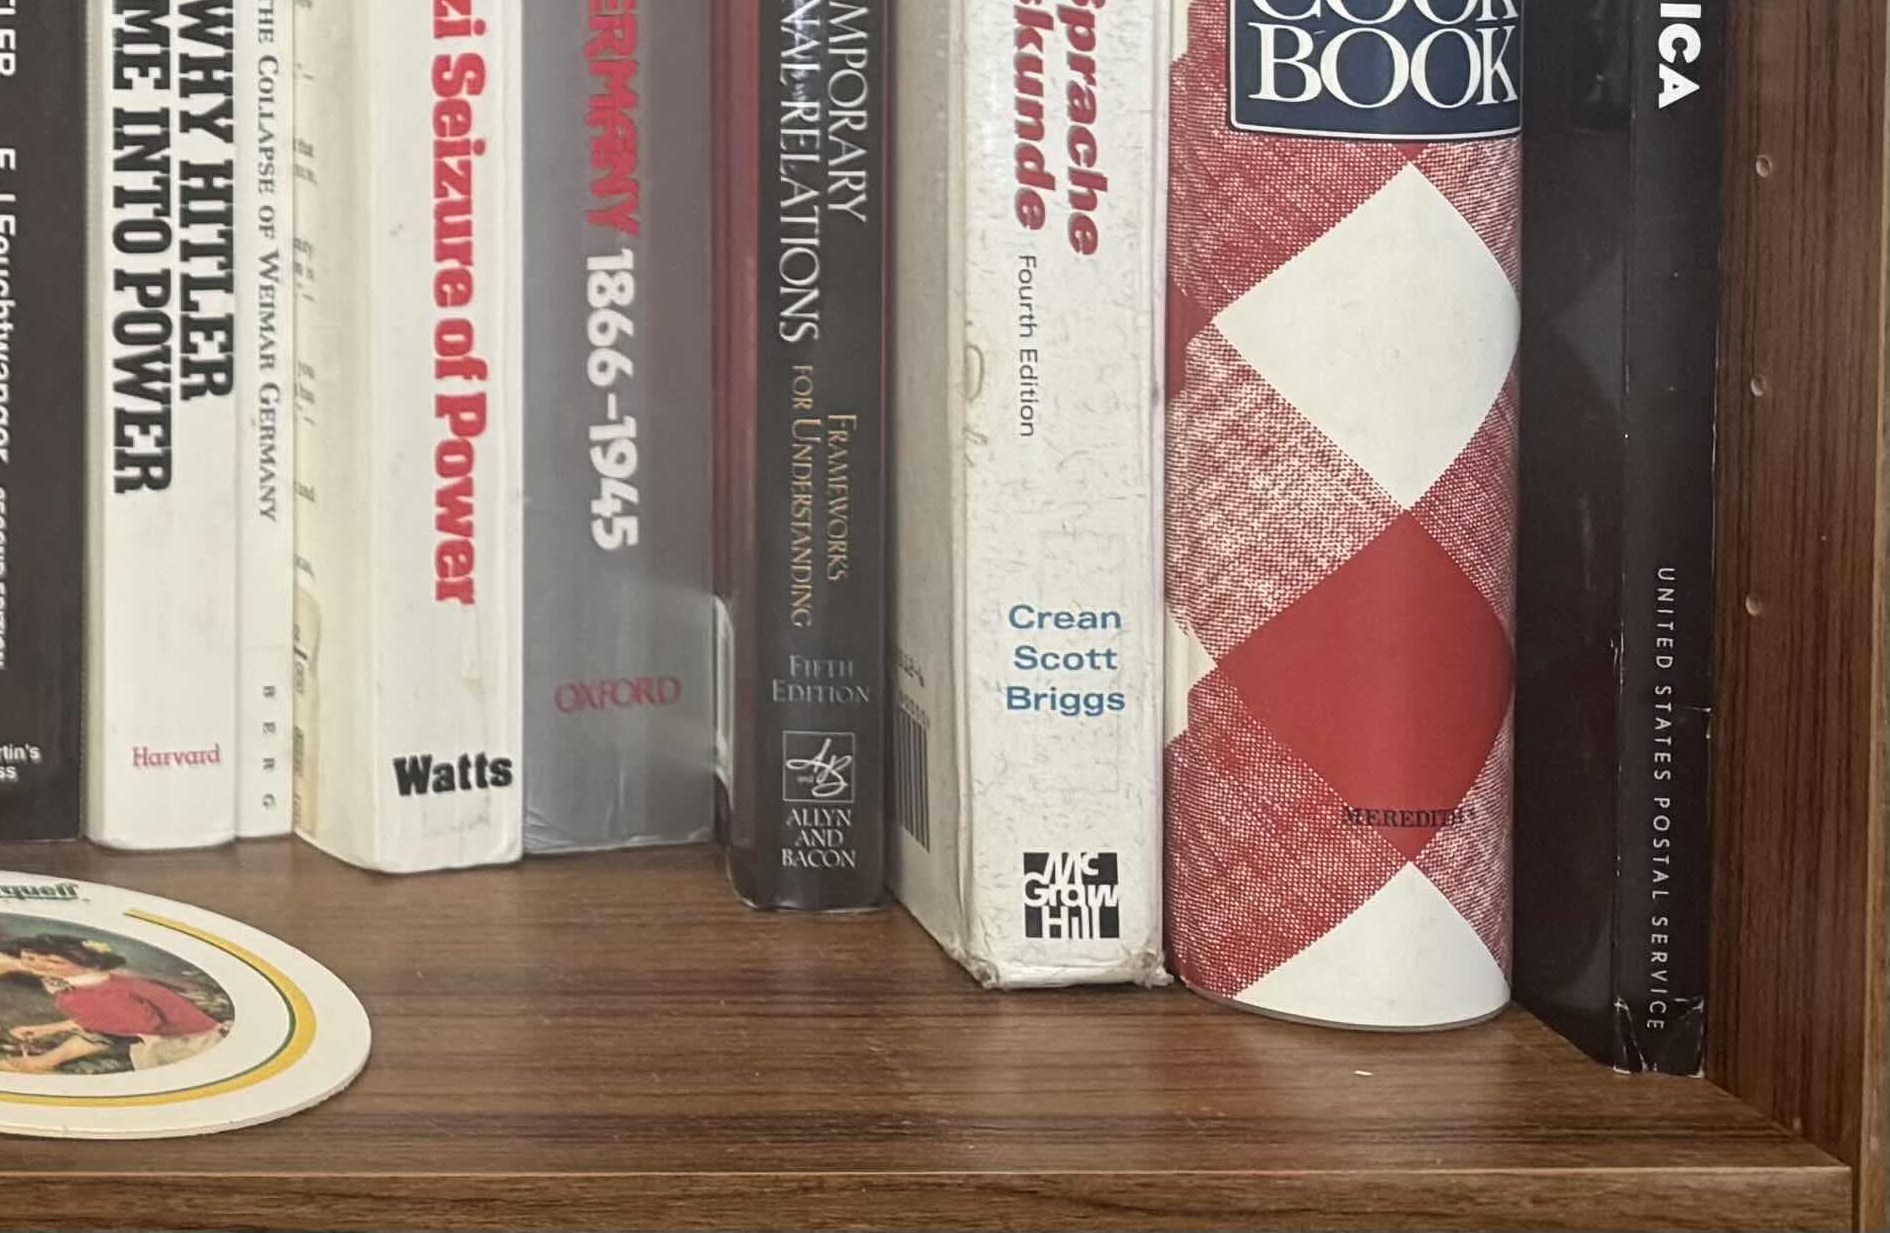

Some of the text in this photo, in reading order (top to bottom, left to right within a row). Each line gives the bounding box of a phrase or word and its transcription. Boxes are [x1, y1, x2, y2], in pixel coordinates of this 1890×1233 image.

[1249, 26, 1518, 109] BOOK
[779, 101, 821, 343] RELATIONS
[1017, 254, 1039, 437] Fourth Edition
[1008, 605, 1121, 630] Crean
[1013, 645, 1118, 671] Scott
[555, 675, 680, 713] OXFORD
[1005, 685, 1126, 716] Briggs
[132, 745, 222, 768] Harvard
[393, 750, 513, 795] Watts
[1646, 567, 1675, 1033] UNITED STATES POSTAL SERVICE
